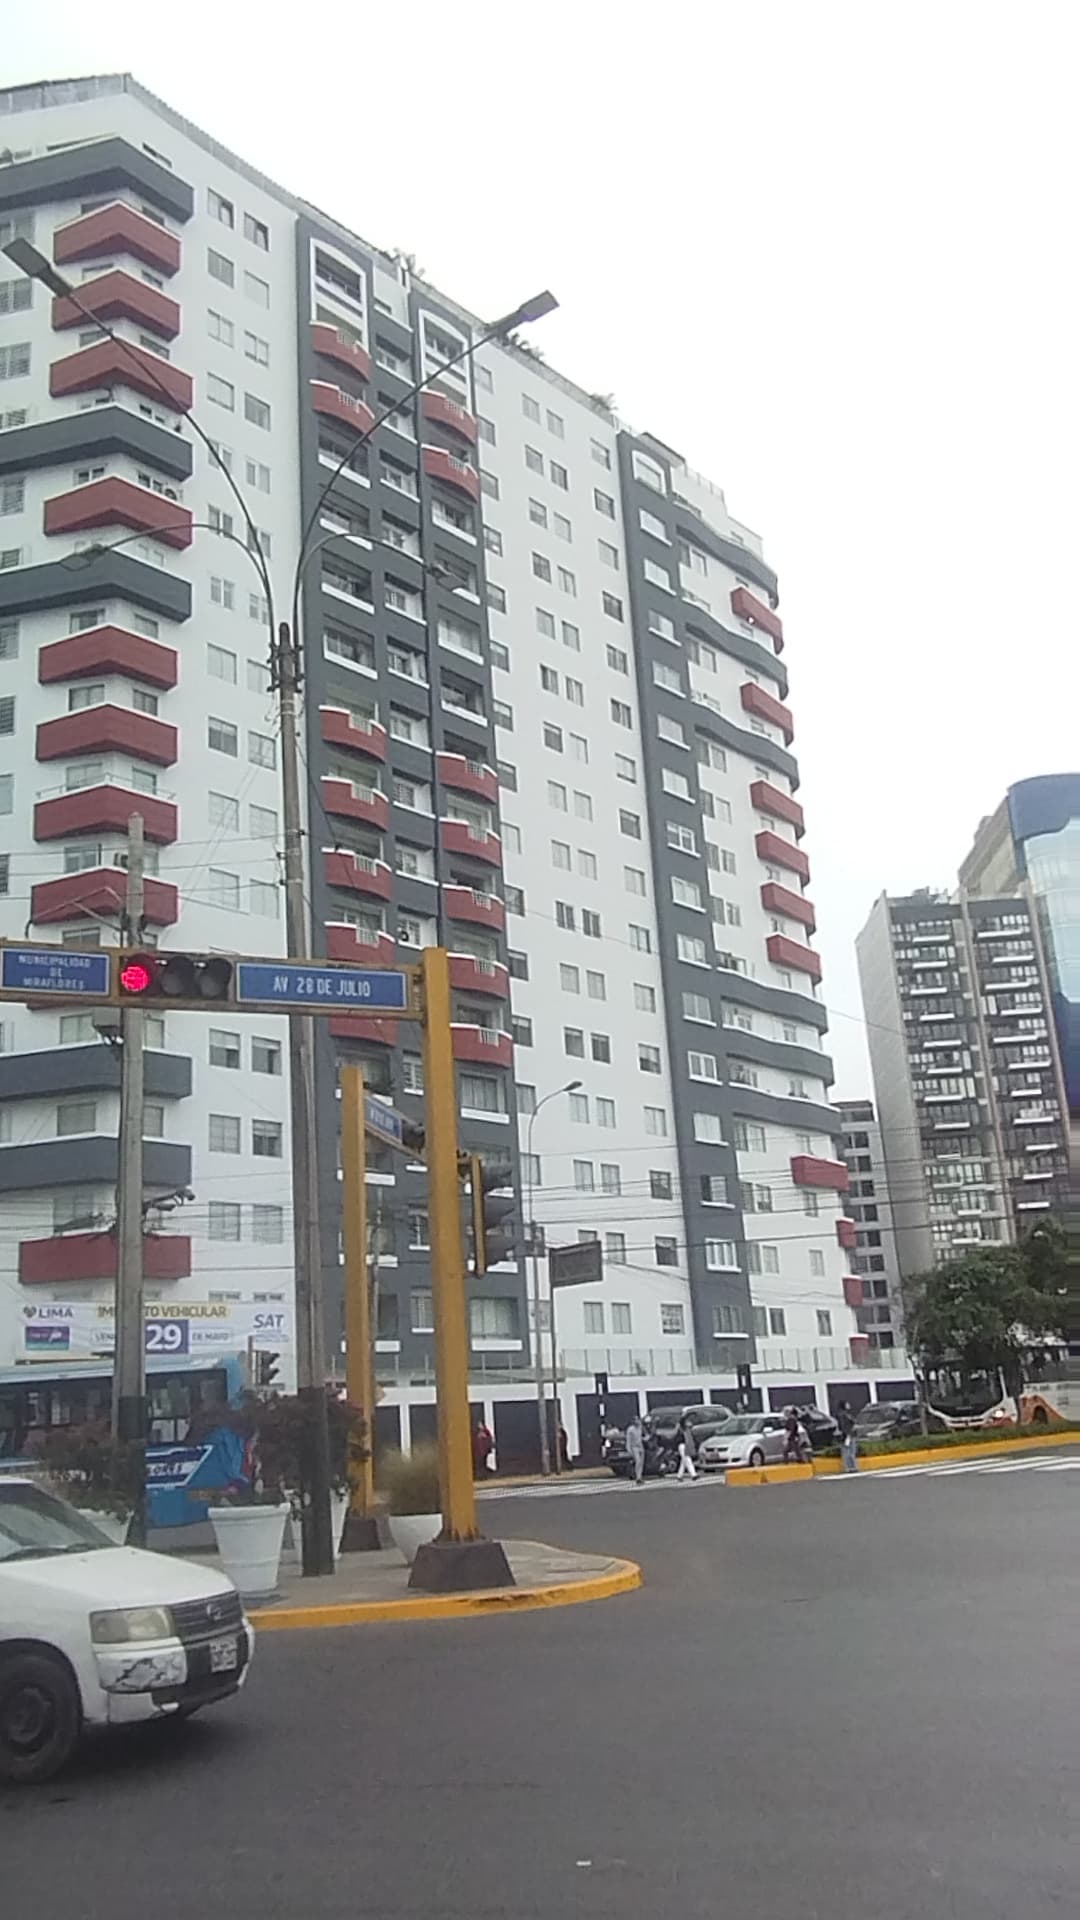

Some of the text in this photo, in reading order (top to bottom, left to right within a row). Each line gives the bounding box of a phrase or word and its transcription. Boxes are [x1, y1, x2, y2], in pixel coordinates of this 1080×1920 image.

[18, 954, 91, 968] MUNICIPALIDAD
[49, 967, 62, 977] DE
[23, 977, 84, 990] MIRAFLORES
[273, 975, 371, 998] AV 28 DE JULIO
[39, 1307, 73, 1319] LIMA
[161, 1305, 227, 1318] VEHICULAR
[253, 1314, 284, 1328] SAT
[146, 1324, 182, 1350] 29
